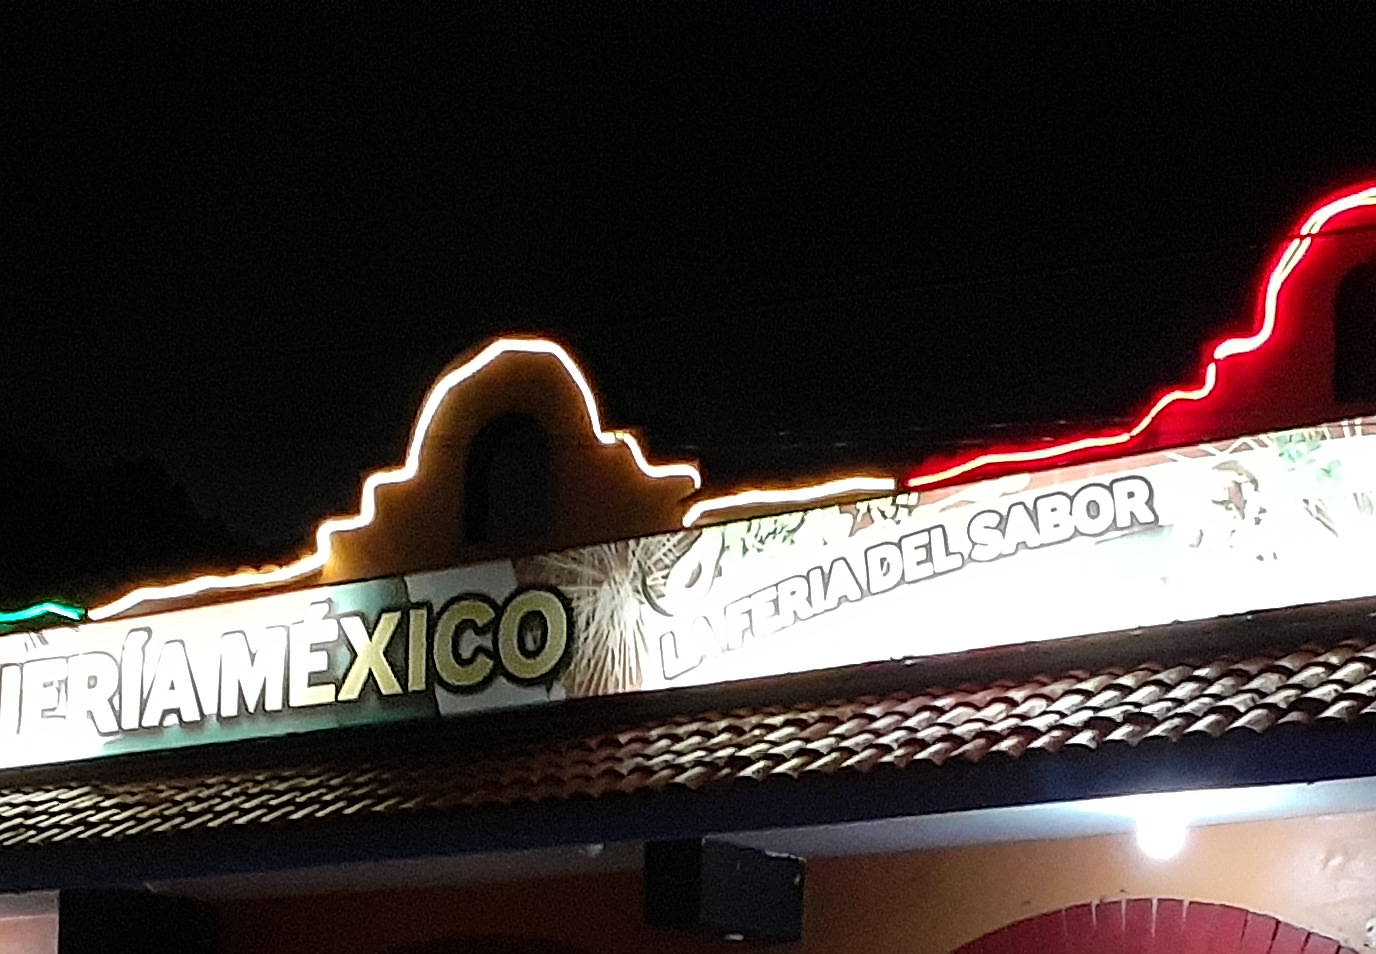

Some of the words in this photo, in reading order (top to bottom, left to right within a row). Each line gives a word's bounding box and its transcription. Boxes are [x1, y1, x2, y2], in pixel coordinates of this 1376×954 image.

[723, 555, 864, 653] FERIA
[864, 524, 965, 596] DEL
[966, 474, 1161, 563] SABOR
[218, 584, 578, 724] MÉXICO
